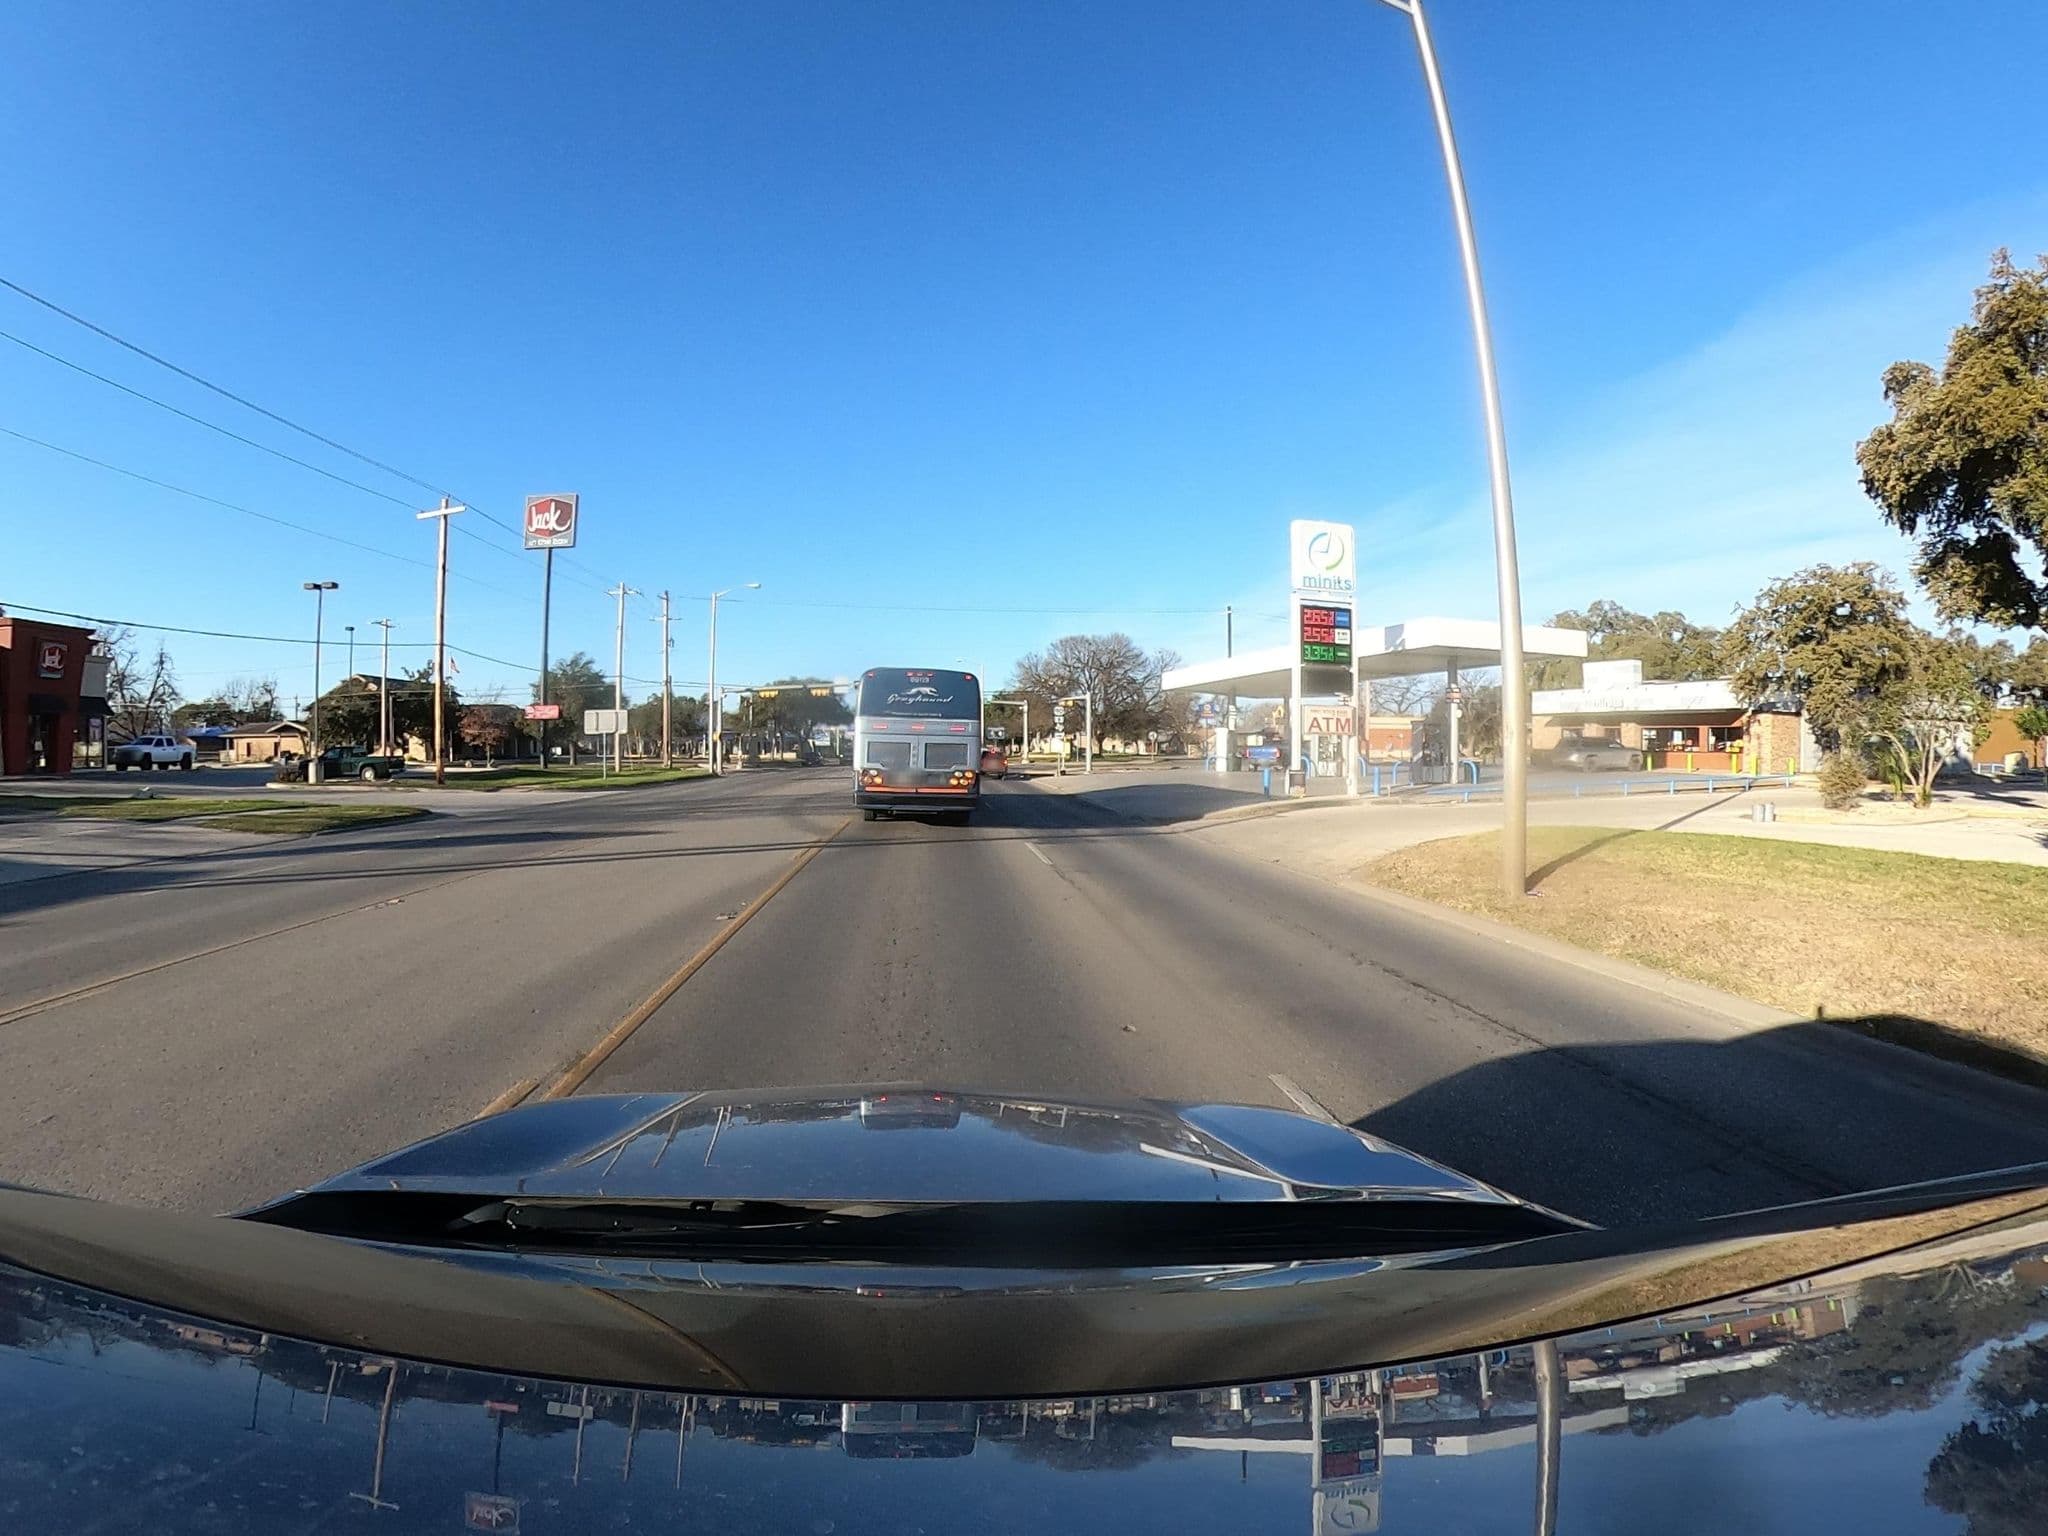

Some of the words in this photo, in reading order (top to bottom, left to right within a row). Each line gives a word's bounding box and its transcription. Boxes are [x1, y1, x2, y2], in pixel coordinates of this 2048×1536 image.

[528, 501, 571, 532] Jack
[1303, 574, 1352, 590] minits
[887, 693, 954, 705] Greyhound
[1308, 717, 1351, 732] ATM
